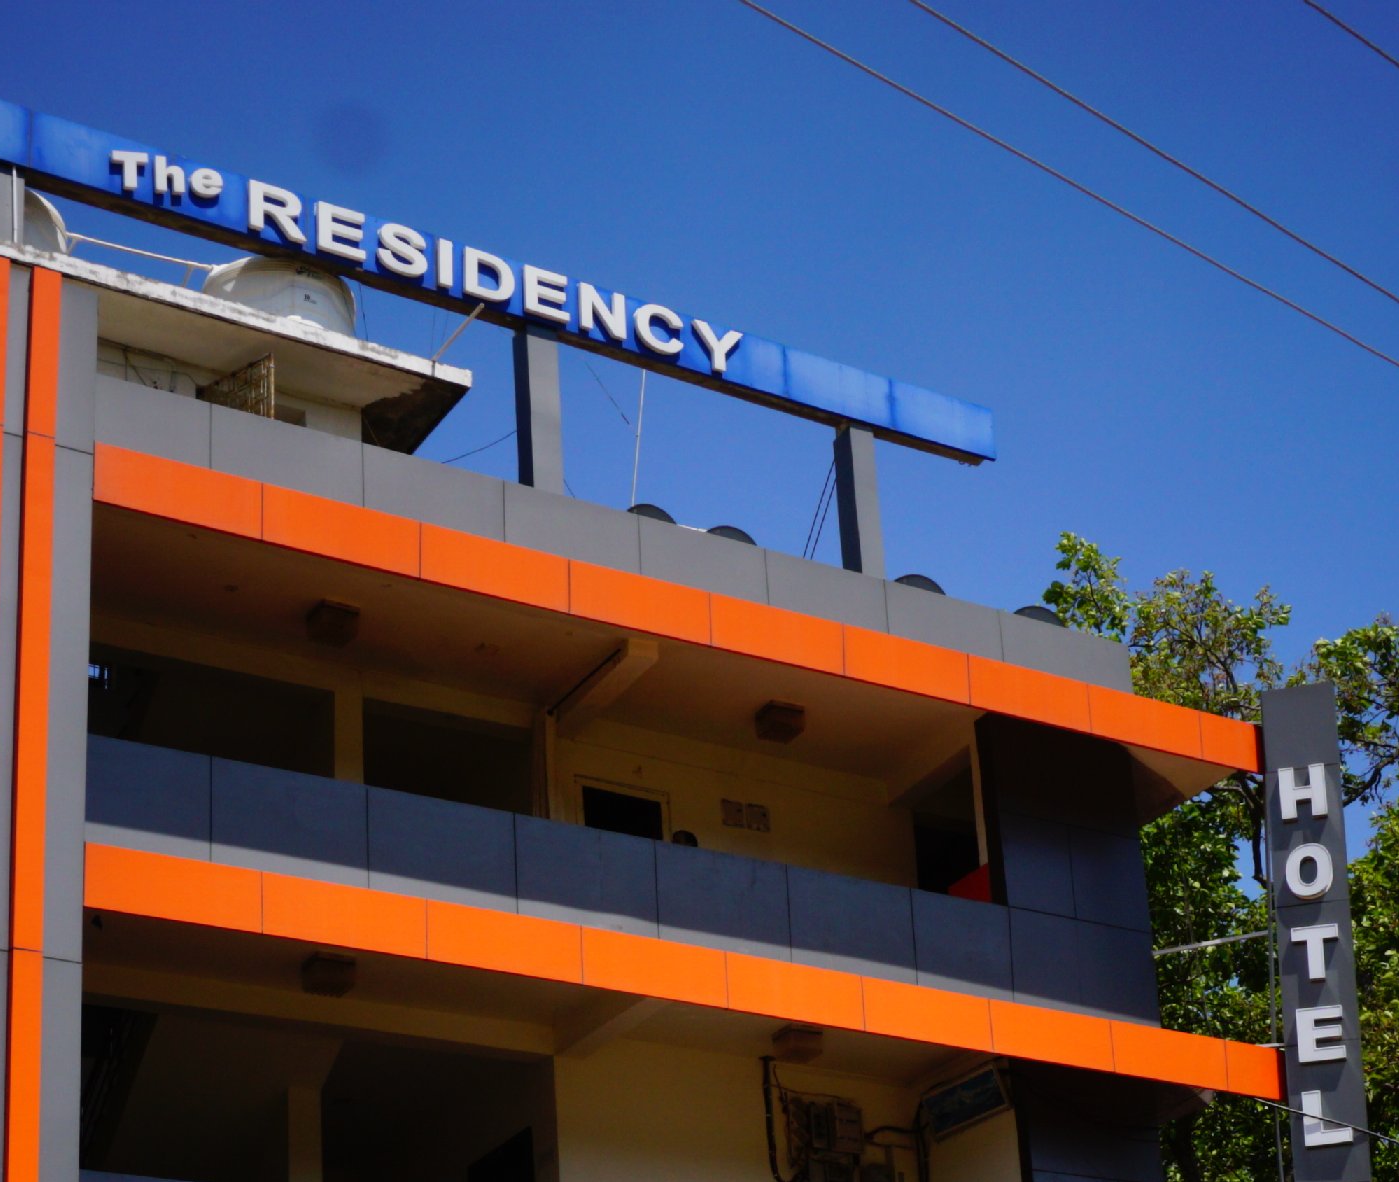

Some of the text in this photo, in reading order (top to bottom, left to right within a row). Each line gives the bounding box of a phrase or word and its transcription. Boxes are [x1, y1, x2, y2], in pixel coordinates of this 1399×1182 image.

[110, 150, 742, 373] The RESIDENCY
[1277, 763, 1353, 1147] HOTEL
